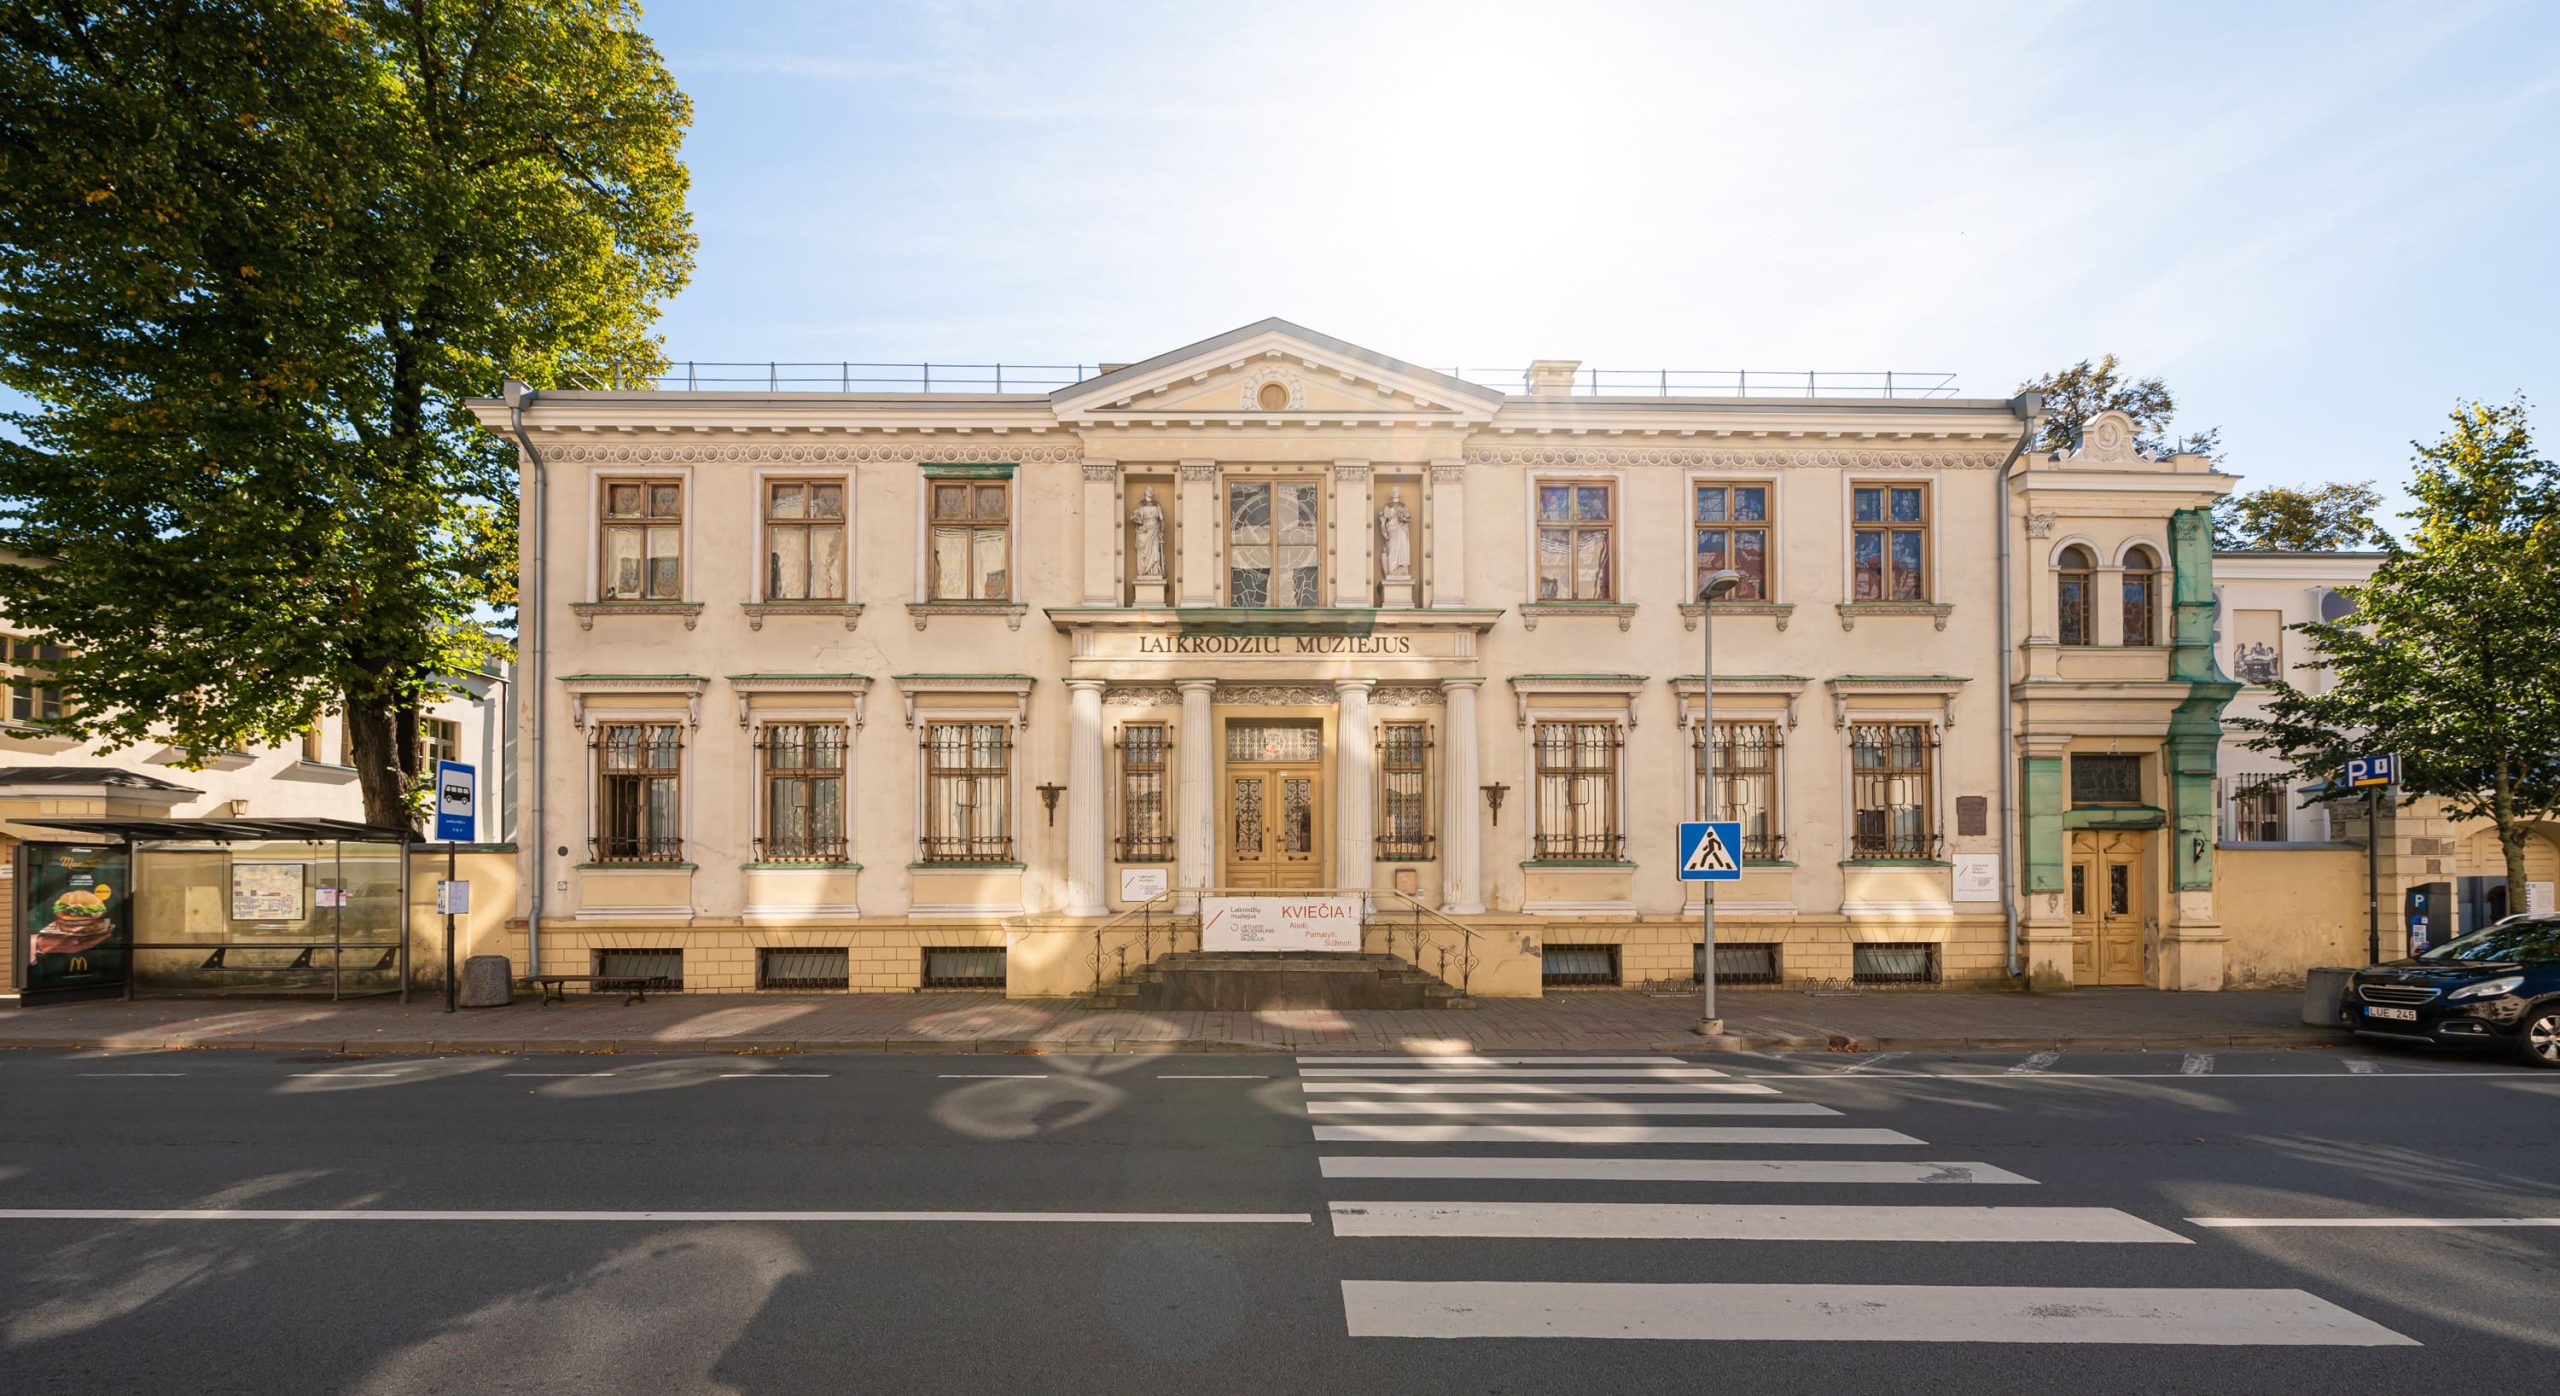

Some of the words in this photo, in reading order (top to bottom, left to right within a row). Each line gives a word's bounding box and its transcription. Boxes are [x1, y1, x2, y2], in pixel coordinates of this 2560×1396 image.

[1296, 636, 1410, 654] MUZIEJUS
[2348, 760, 2367, 787] P
[2415, 894, 2425, 908] P
[1282, 903, 1345, 919] KVIEČIA
[2370, 1007, 2390, 1018] LUE
[2396, 1009, 2414, 1020] 245
